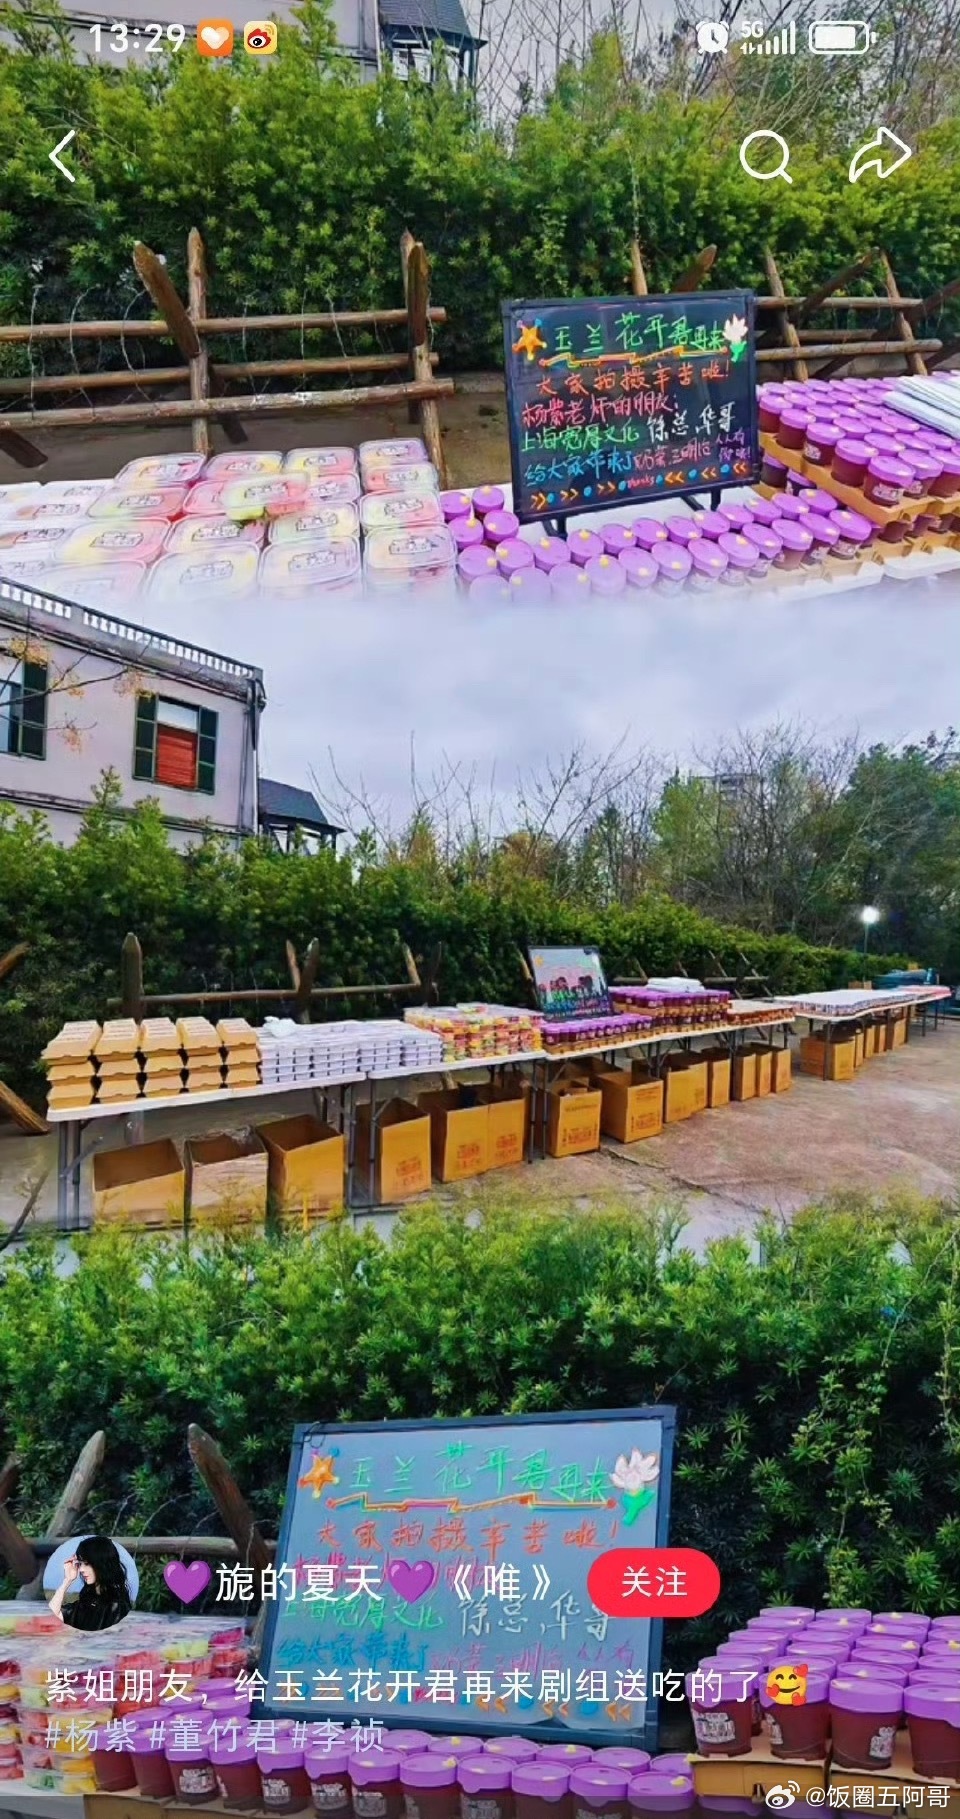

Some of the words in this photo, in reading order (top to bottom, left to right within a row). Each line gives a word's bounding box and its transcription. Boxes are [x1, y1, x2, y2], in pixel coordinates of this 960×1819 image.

[554, 311, 725, 353] 玉兰花开君再来
[350, 1439, 612, 1504] 玉兰花开君再来
